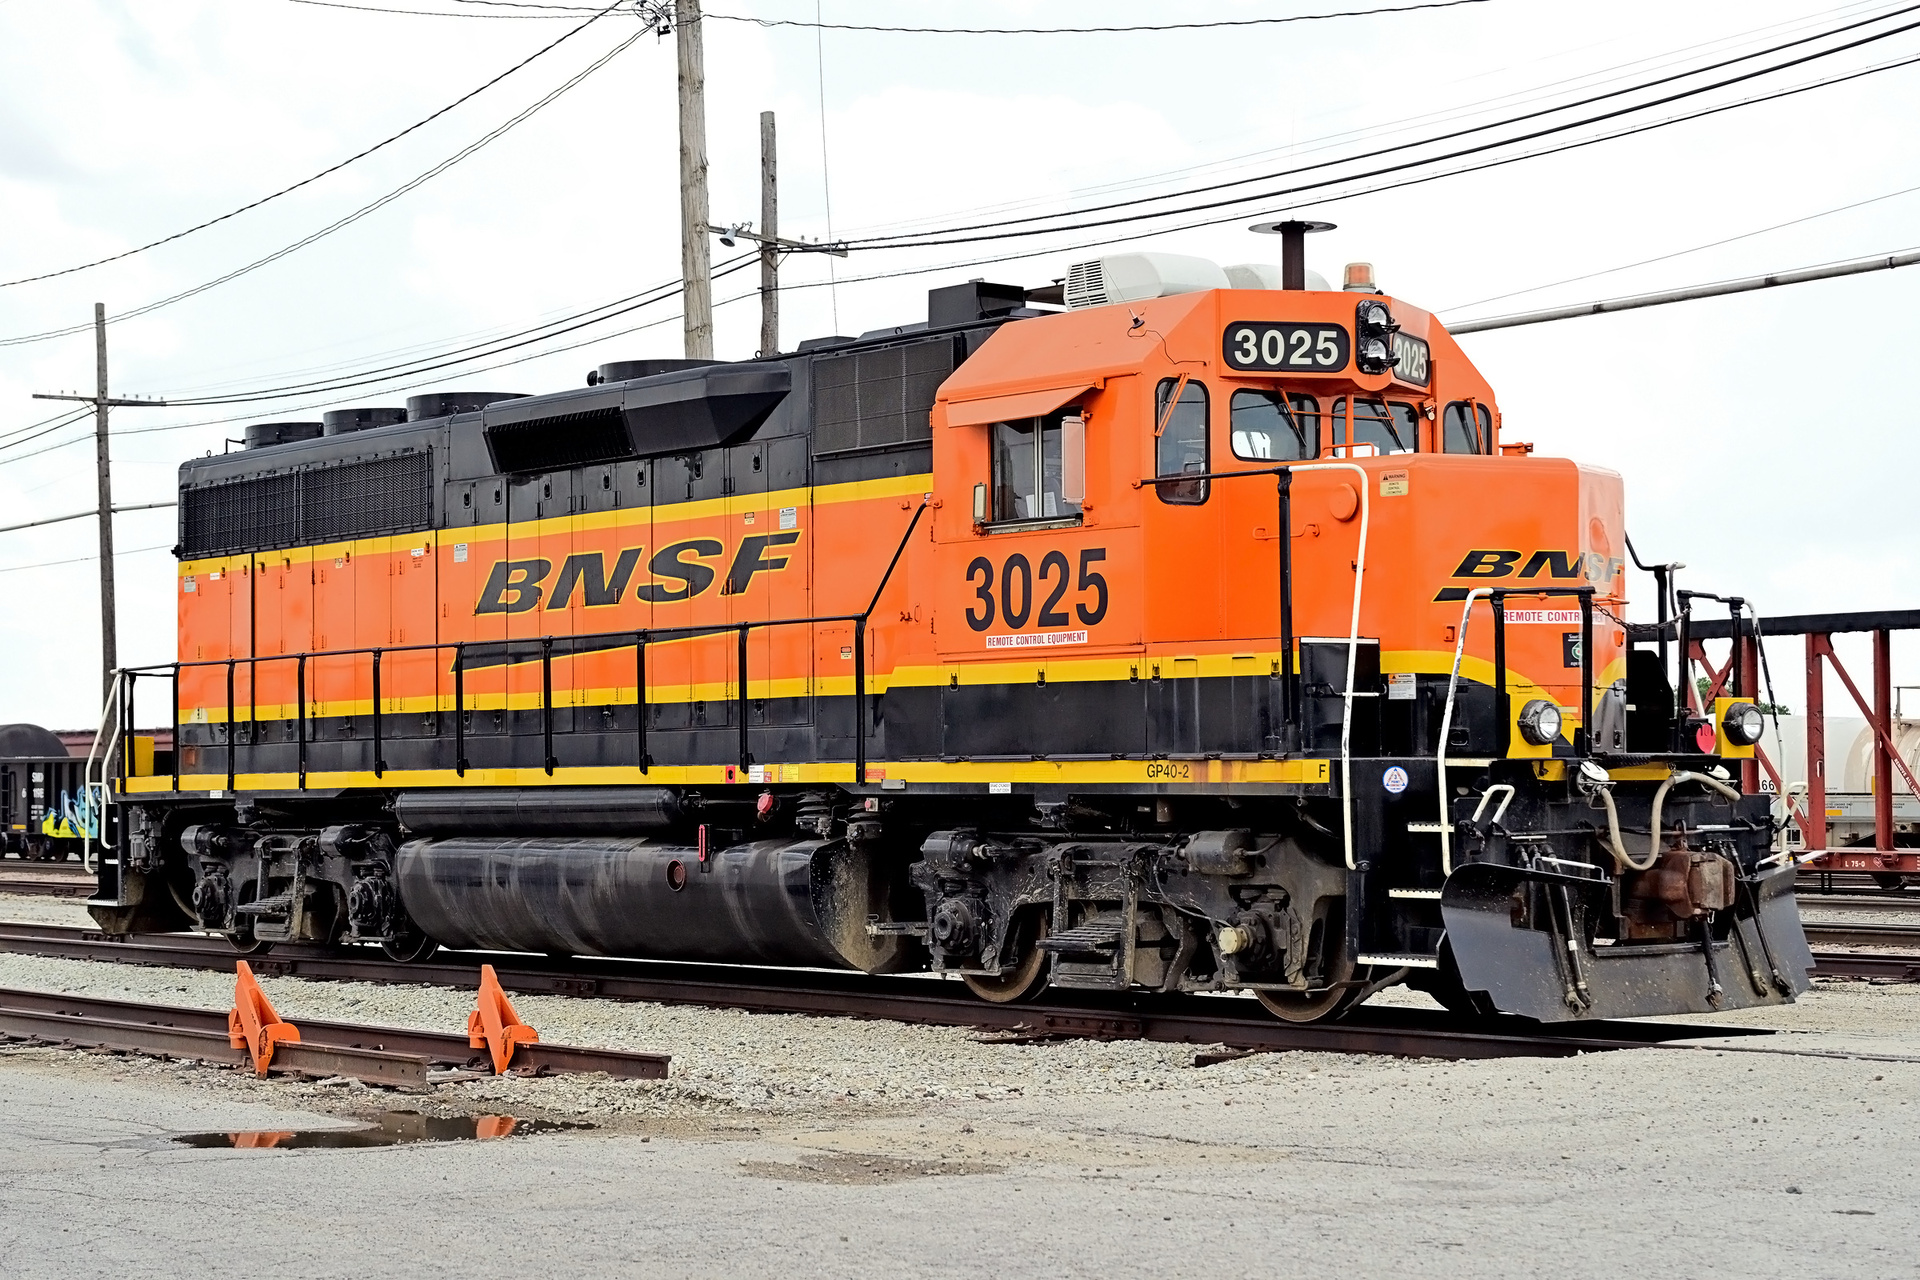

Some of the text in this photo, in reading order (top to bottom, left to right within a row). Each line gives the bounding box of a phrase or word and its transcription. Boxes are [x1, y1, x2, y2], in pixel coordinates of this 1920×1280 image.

[1234, 328, 1339, 366] 3025
[1395, 337, 1427, 380] 3025
[473, 528, 804, 616] BNSF
[1449, 548, 1625, 585] BNSF
[965, 547, 1109, 632] 3025
[1503, 611, 1543, 622] REMOTE
[1547, 611, 1583, 622] CONTR
[988, 631, 1086, 647] REMOTE CONTROL EQUIPMENT
[1146, 764, 1190, 779] GP40-2
[1318, 763, 1327, 778] F
